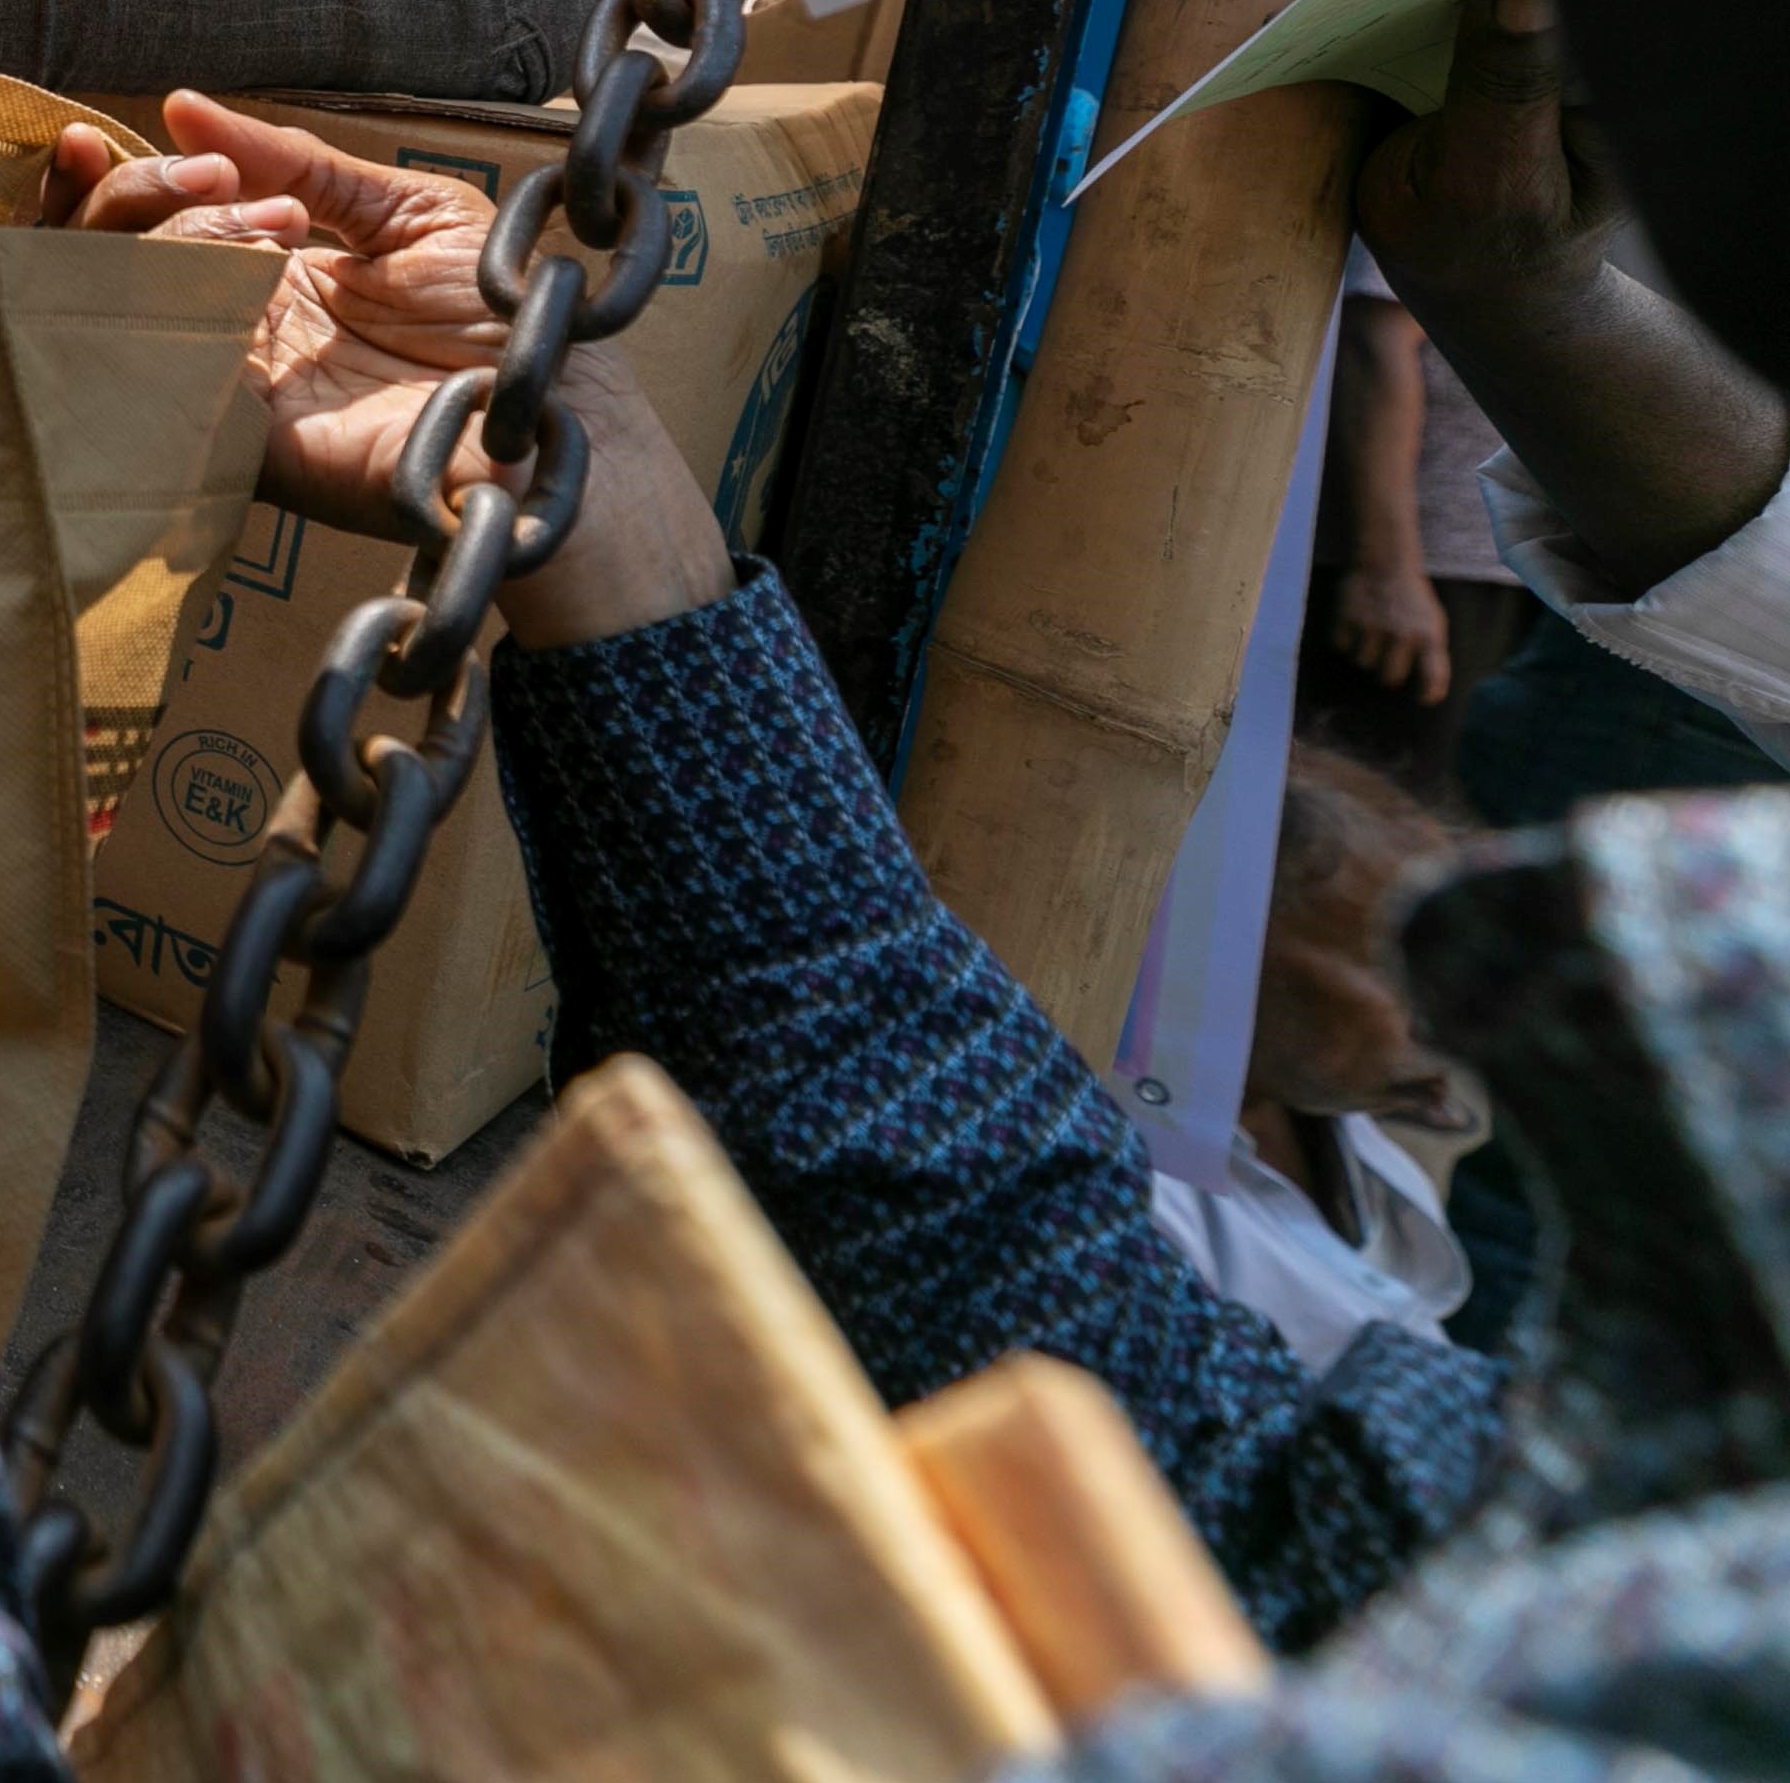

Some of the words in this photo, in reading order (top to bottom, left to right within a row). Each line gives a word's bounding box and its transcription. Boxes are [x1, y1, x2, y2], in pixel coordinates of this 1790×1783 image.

[197, 735, 238, 758] RICH
[240, 749, 259, 769] IN
[191, 765, 254, 805] VITAMIN
[183, 782, 252, 834] E&K
